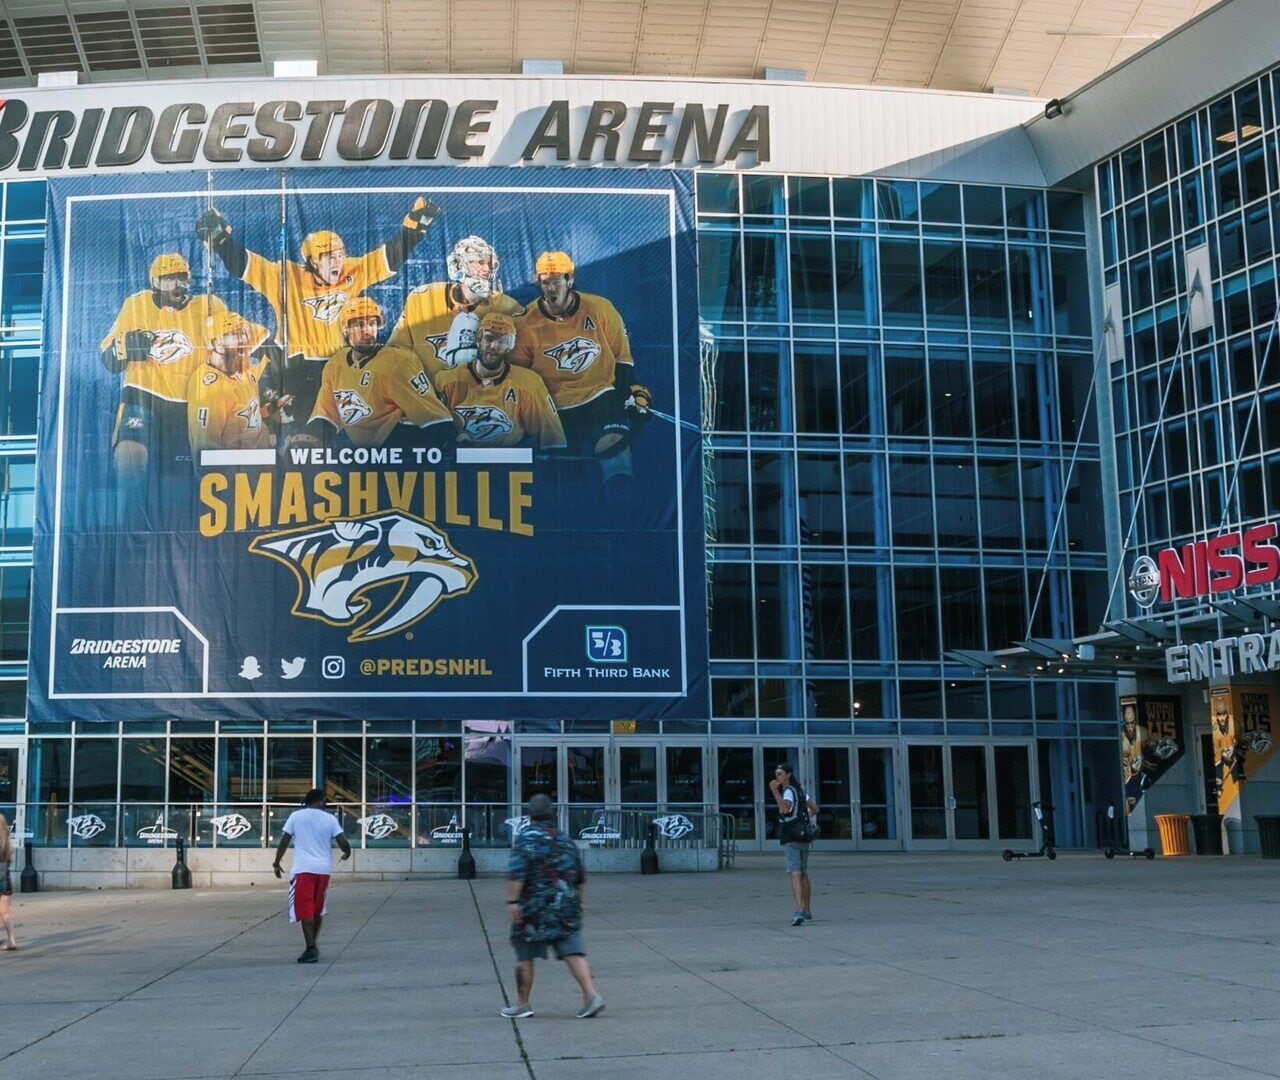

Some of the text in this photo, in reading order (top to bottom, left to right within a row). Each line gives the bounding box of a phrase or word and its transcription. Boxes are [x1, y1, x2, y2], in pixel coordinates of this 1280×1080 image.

[523, 100, 772, 163] ARENA
[360, 371, 371, 387] C
[408, 370, 430, 396] 59
[505, 387, 516, 403] A
[198, 407, 208, 428] 4
[290, 447, 442, 465] WELCOME TO
[199, 470, 535, 538] SMASHVILLE
[70, 638, 182, 654] BRIDGESTONE
[103, 656, 147, 669] ARENA
[360, 658, 493, 675] @PREDSNHL
[544, 667, 670, 678] FIFTH THIRD BANK
[1147, 721, 1176, 740] US
